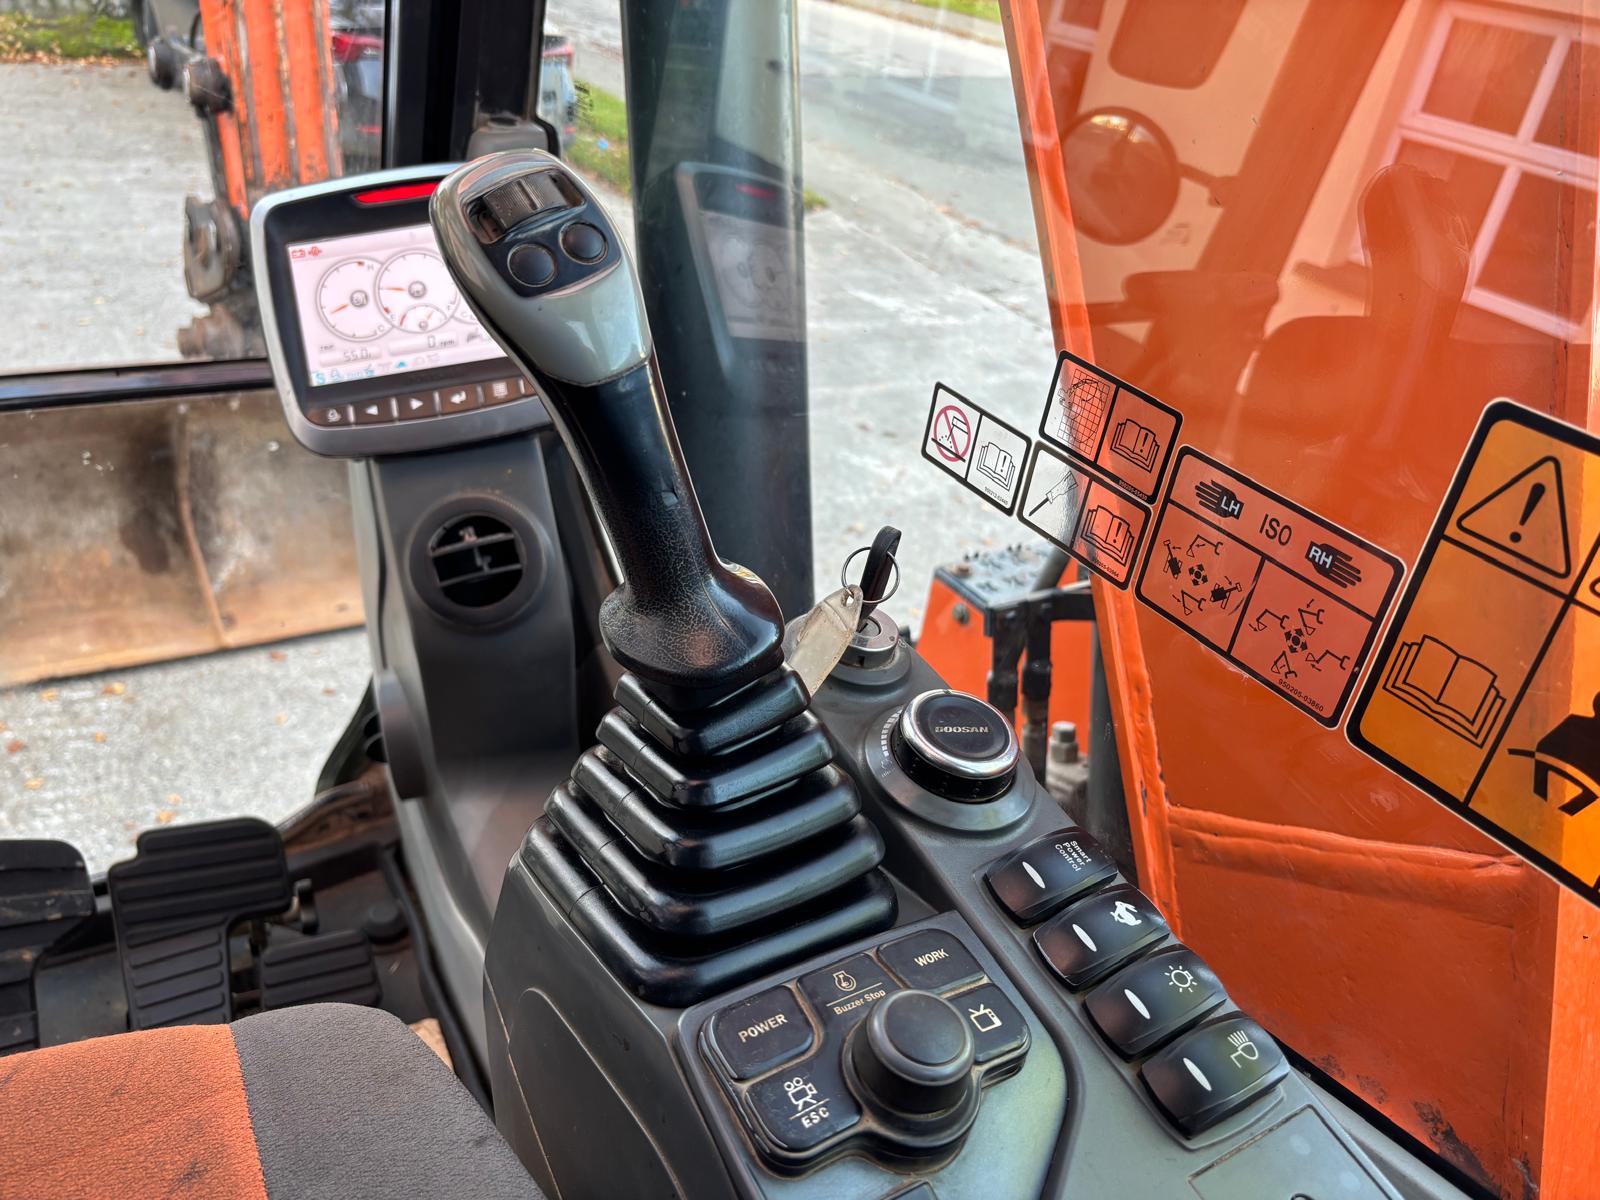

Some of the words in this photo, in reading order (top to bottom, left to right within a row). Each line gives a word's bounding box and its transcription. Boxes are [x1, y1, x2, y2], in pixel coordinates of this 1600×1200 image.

[1220, 495, 1240, 516] LH
[1259, 513, 1293, 546] ISO
[1308, 545, 1333, 569] RH
[1055, 844, 1082, 872] Control
[1062, 841, 1086, 866] Power
[1070, 840, 1092, 863] Smart
[914, 947, 950, 969] WORK
[833, 996, 865, 1016] Buzzer
[864, 988, 887, 1006] Stop
[737, 1012, 788, 1043] POWER
[801, 1106, 830, 1129] ESC
